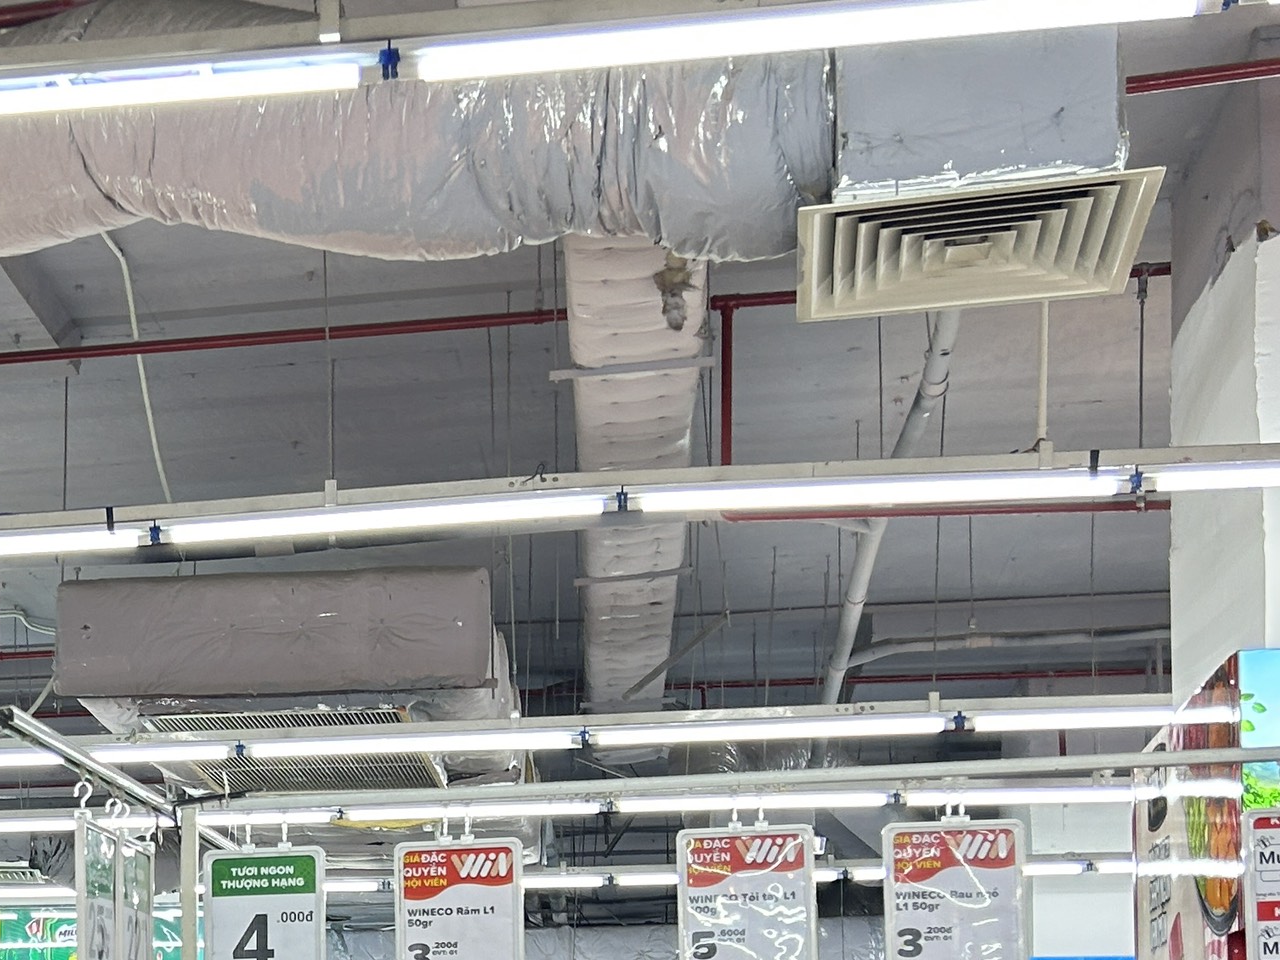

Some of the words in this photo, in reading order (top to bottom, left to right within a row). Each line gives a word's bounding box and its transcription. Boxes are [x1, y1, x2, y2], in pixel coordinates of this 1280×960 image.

[703, 838, 730, 850] ĐẶC
[911, 833, 940, 846] ĐẶC
[421, 851, 447, 863] ĐẶC
[404, 863, 447, 877] QUYỀN
[916, 859, 941, 869] VIÊN
[231, 864, 257, 877] TƯƠI
[260, 865, 294, 876] NGON
[220, 876, 268, 890] THƯỢNG
[270, 876, 305, 890] HẠNG
[424, 877, 447, 887] VIÊN
[784, 891, 796, 900] L1
[950, 890, 973, 899] Rau
[407, 907, 453, 917] WINECO
[484, 906, 495, 915] L1
[896, 902, 909, 911] L1
[912, 902, 940, 912] 50gr
[407, 919, 433, 929] 50gr
[692, 931, 718, 960] 5
[897, 928, 923, 958] 3
